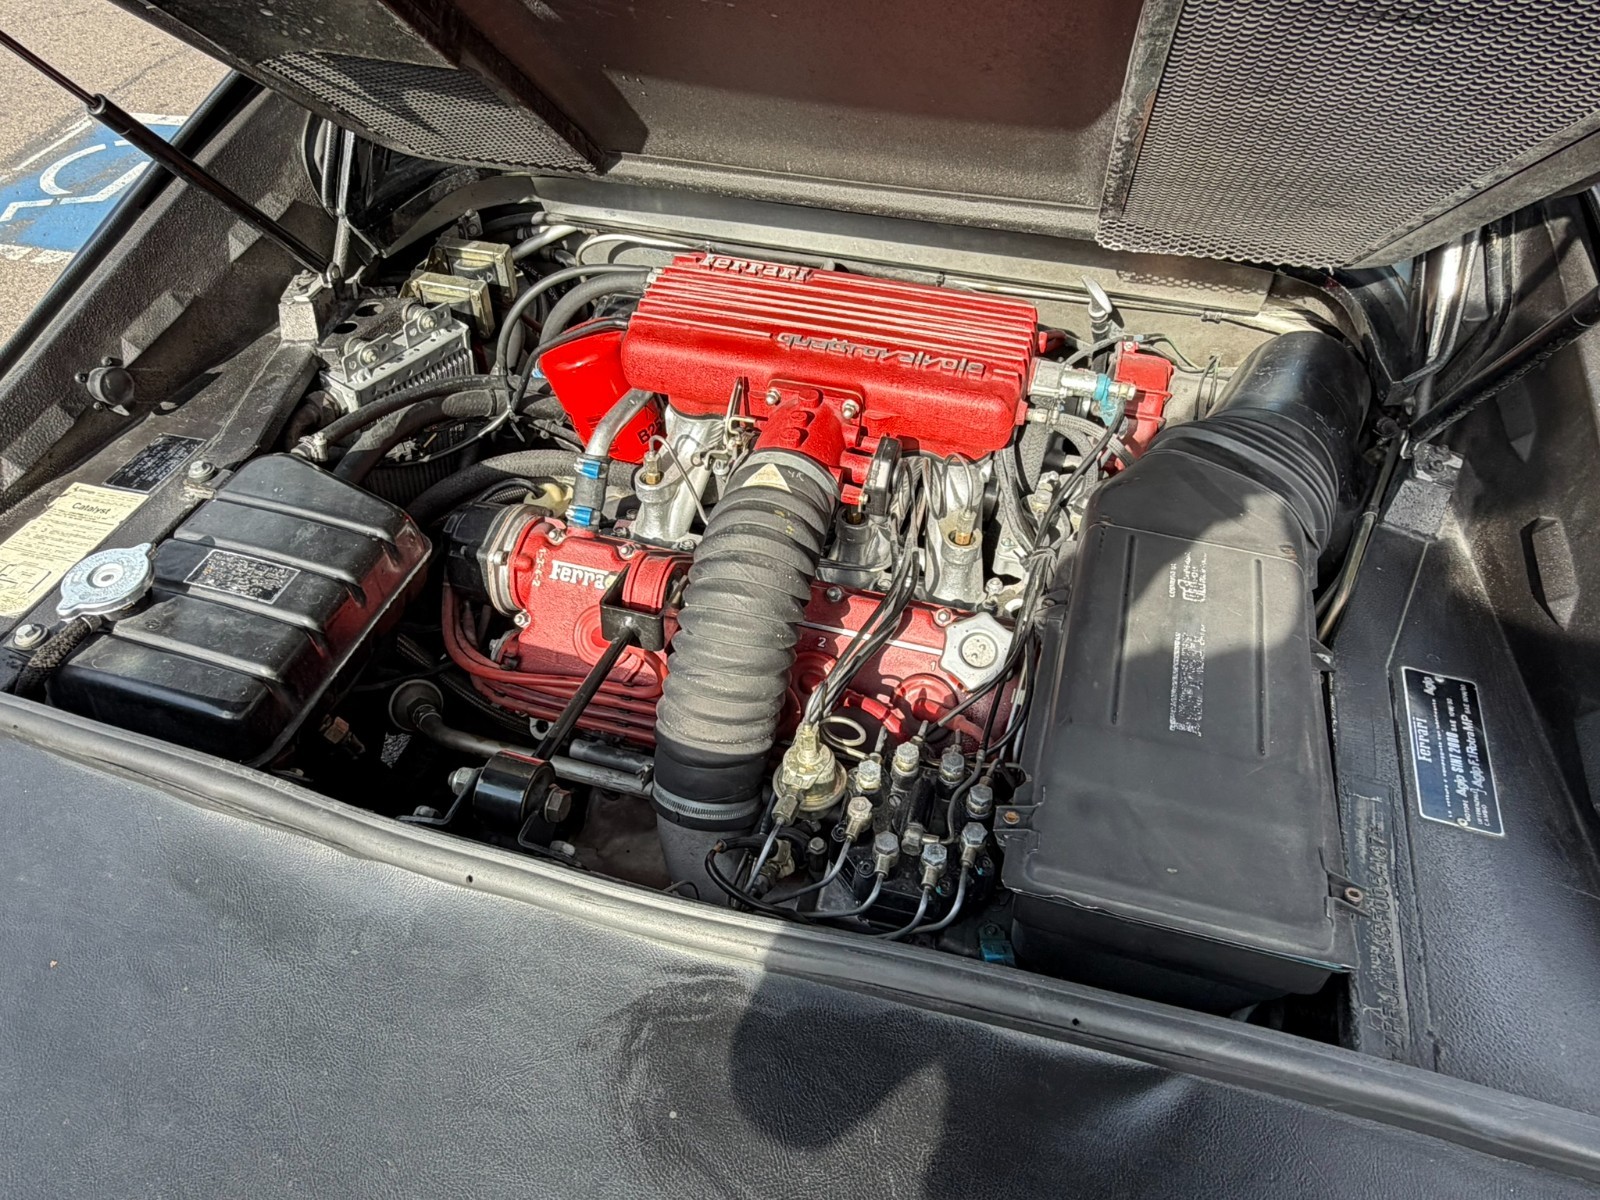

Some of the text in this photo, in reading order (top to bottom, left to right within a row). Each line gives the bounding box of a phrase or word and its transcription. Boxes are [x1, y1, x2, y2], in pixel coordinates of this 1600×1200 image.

[700, 253, 812, 281] Ferrari
[777, 332, 985, 375] quattrovalvole
[72, 502, 111, 516] Catalyst
[549, 560, 618, 590] Ferra
[818, 637, 827, 648] 2
[1422, 677, 1436, 695] Agip
[1412, 716, 1432, 762] Ferrari
[1445, 730, 1461, 754] 2000
[1448, 753, 1464, 773] SINT
[1454, 775, 1470, 797] Agip
[1470, 767, 1485, 788] Agip
